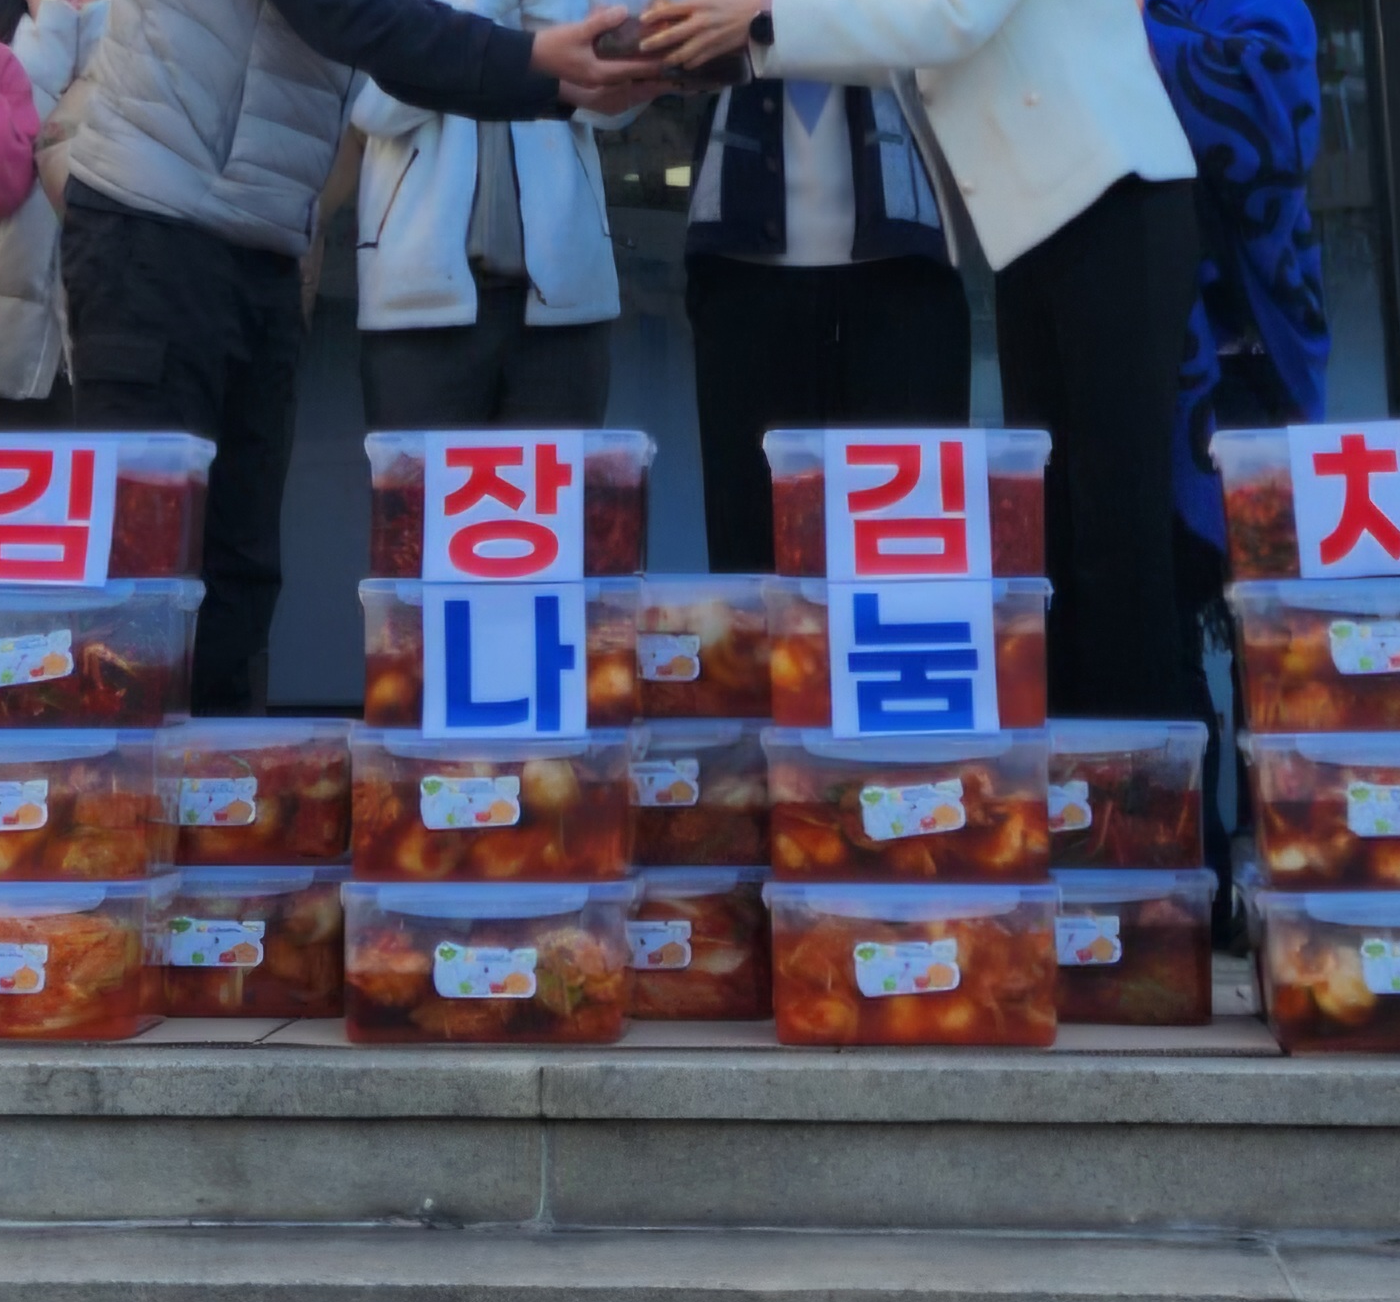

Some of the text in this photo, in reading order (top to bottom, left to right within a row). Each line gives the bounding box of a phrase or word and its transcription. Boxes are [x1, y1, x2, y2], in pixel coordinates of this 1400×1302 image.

[444, 443, 572, 578] 장
[845, 441, 969, 575] 김
[443, 592, 979, 733] 나 눔
